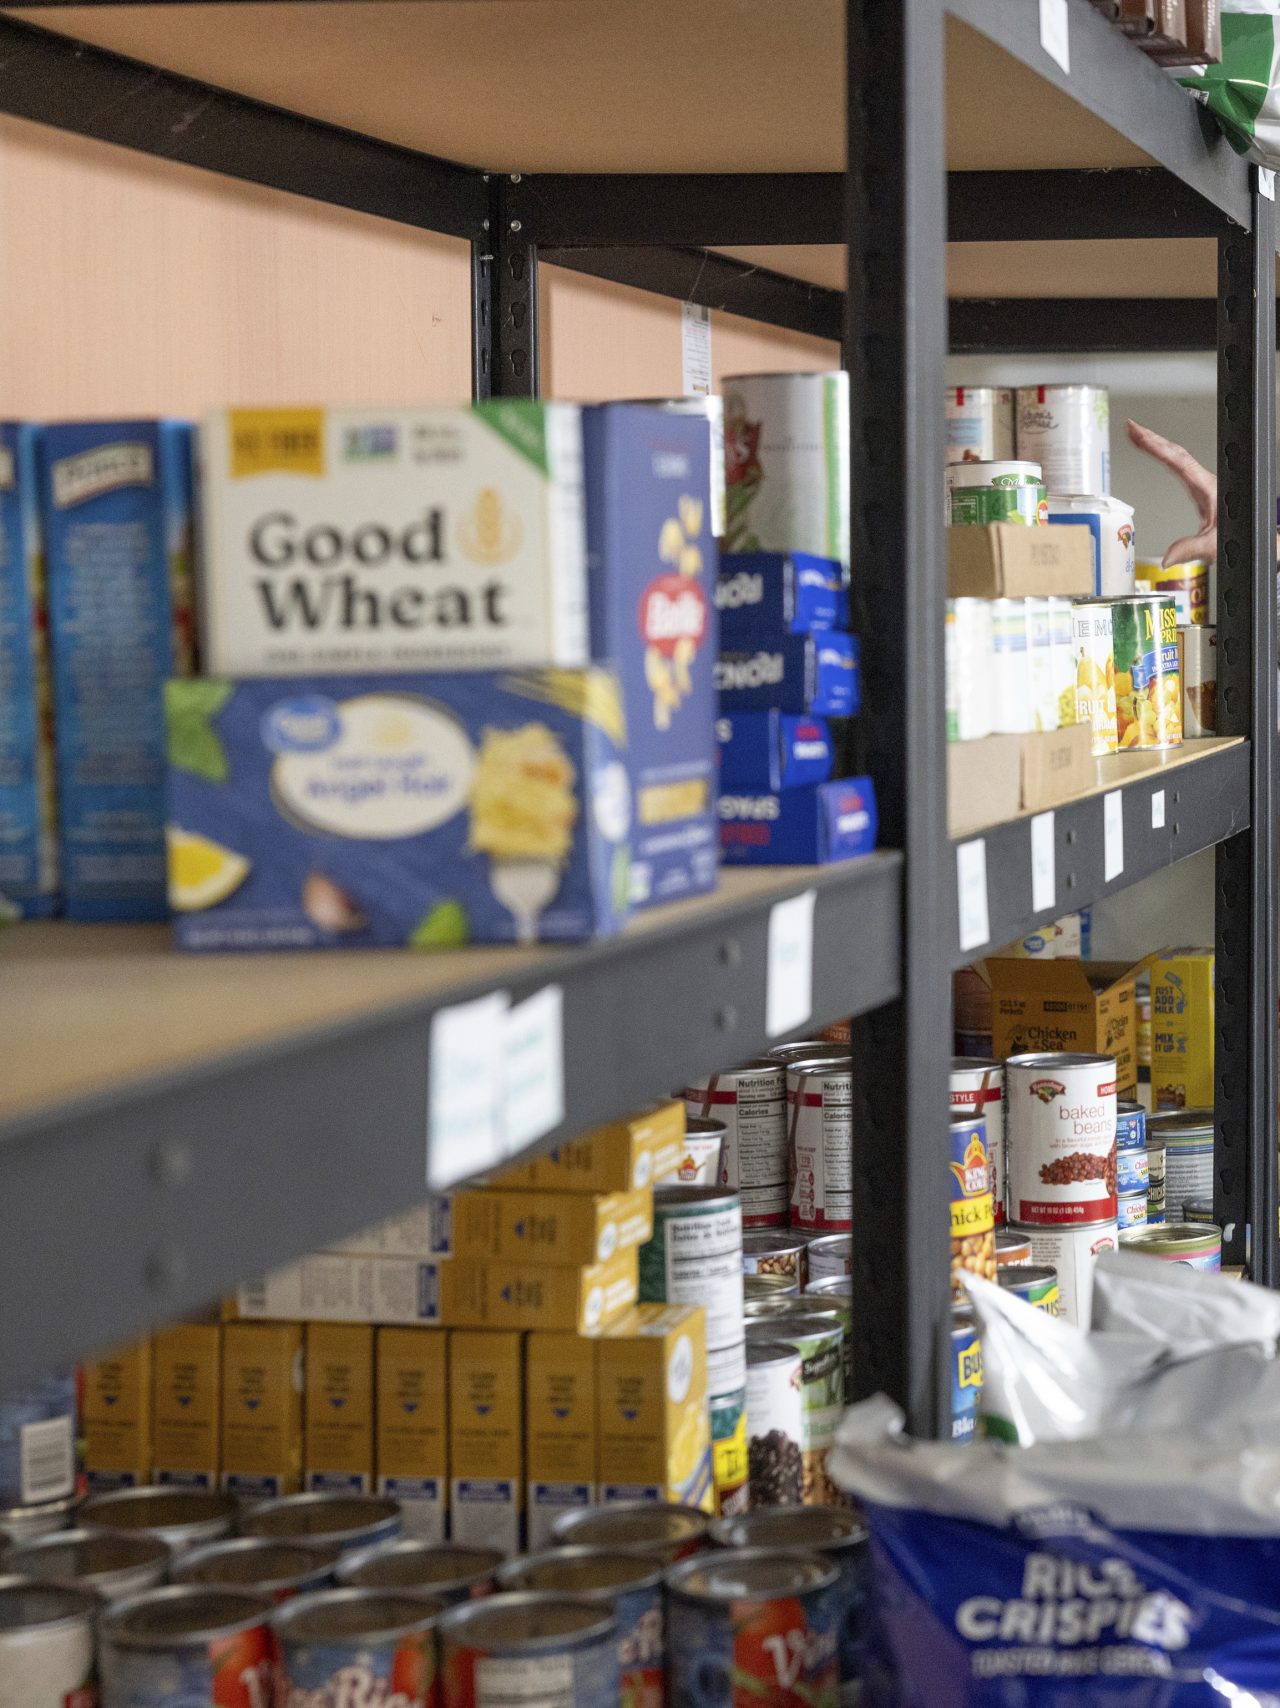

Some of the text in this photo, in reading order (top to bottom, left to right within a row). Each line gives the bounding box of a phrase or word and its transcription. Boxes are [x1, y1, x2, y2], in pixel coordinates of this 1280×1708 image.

[250, 506, 446, 567] Good
[253, 575, 508, 633] Wheat
[1160, 629, 1177, 643] PRI
[1155, 986, 1175, 994] JUST
[1155, 995, 1175, 1005] ADD
[1155, 1005, 1175, 1014] MILK
[1028, 1026, 1077, 1043] Chicken
[1155, 1033, 1175, 1043] MIX
[1041, 1040, 1064, 1051] Sea
[738, 1079, 775, 1088] Nutrition
[739, 1108, 769, 1116] Calories
[1059, 1103, 1105, 1120] baked
[1073, 1120, 1112, 1135] beans
[963, 1351, 982, 1380] BU
[951, 1415, 974, 1438] Bla
[955, 1589, 1192, 1650] CRISPIES
